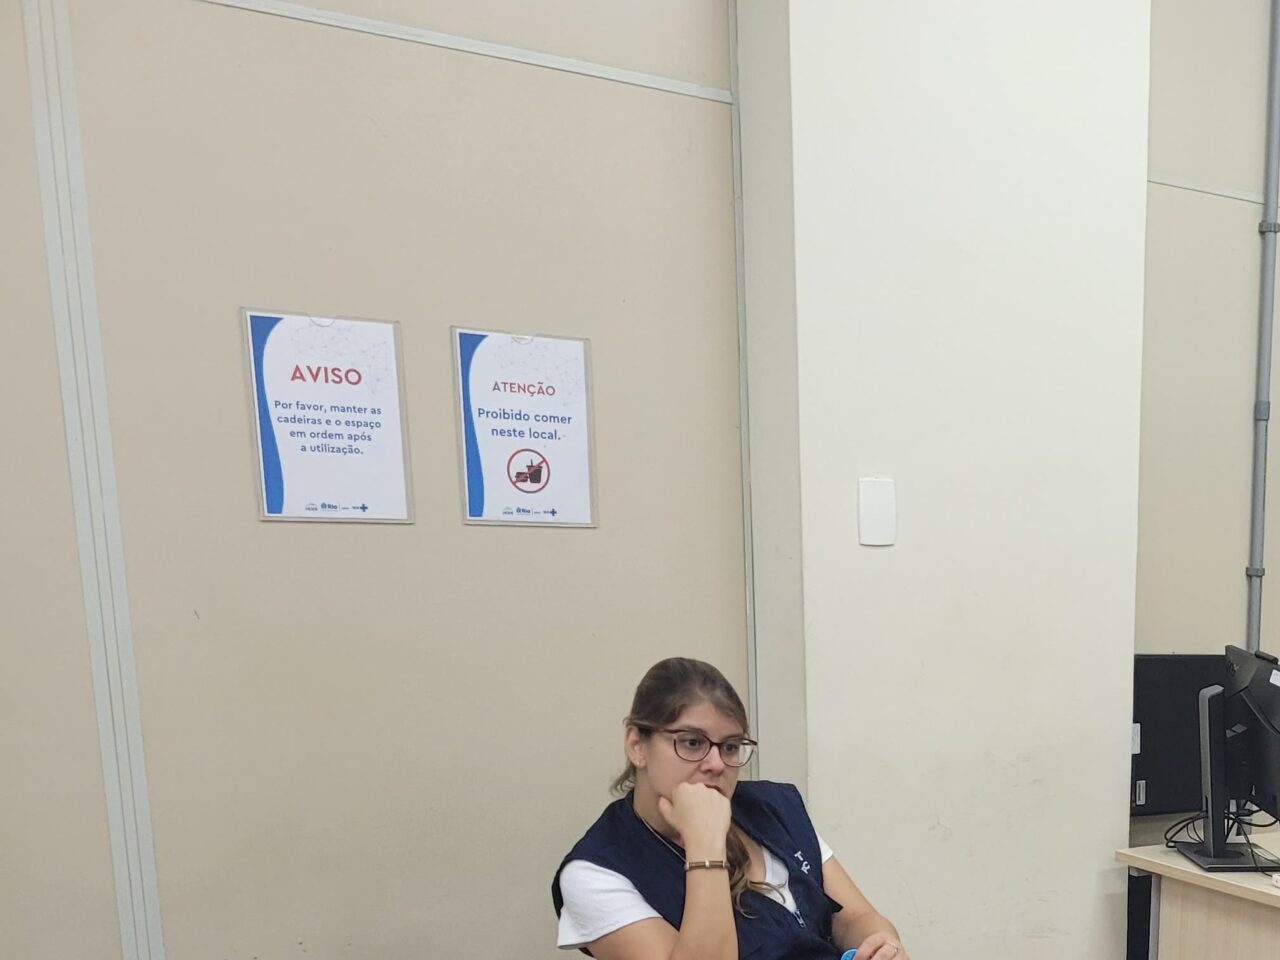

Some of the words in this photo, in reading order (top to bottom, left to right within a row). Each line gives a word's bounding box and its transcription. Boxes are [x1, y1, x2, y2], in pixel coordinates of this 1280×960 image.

[290, 364, 362, 386] AVISO
[492, 380, 556, 397] ATENÇÃO
[274, 400, 293, 410] Por
[295, 400, 327, 413] favor,
[330, 404, 367, 414] manter
[277, 414, 322, 425] cadeiras
[325, 418, 332, 426] e
[344, 419, 382, 430] espaço
[477, 408, 530, 421] Proibido
[534, 413, 572, 424] comer
[289, 430, 306, 439] em
[309, 430, 344, 441] ordem
[347, 432, 372, 443] após
[491, 427, 525, 438] neste
[529, 427, 561, 441] local.
[310, 443, 364, 456] utilização.
